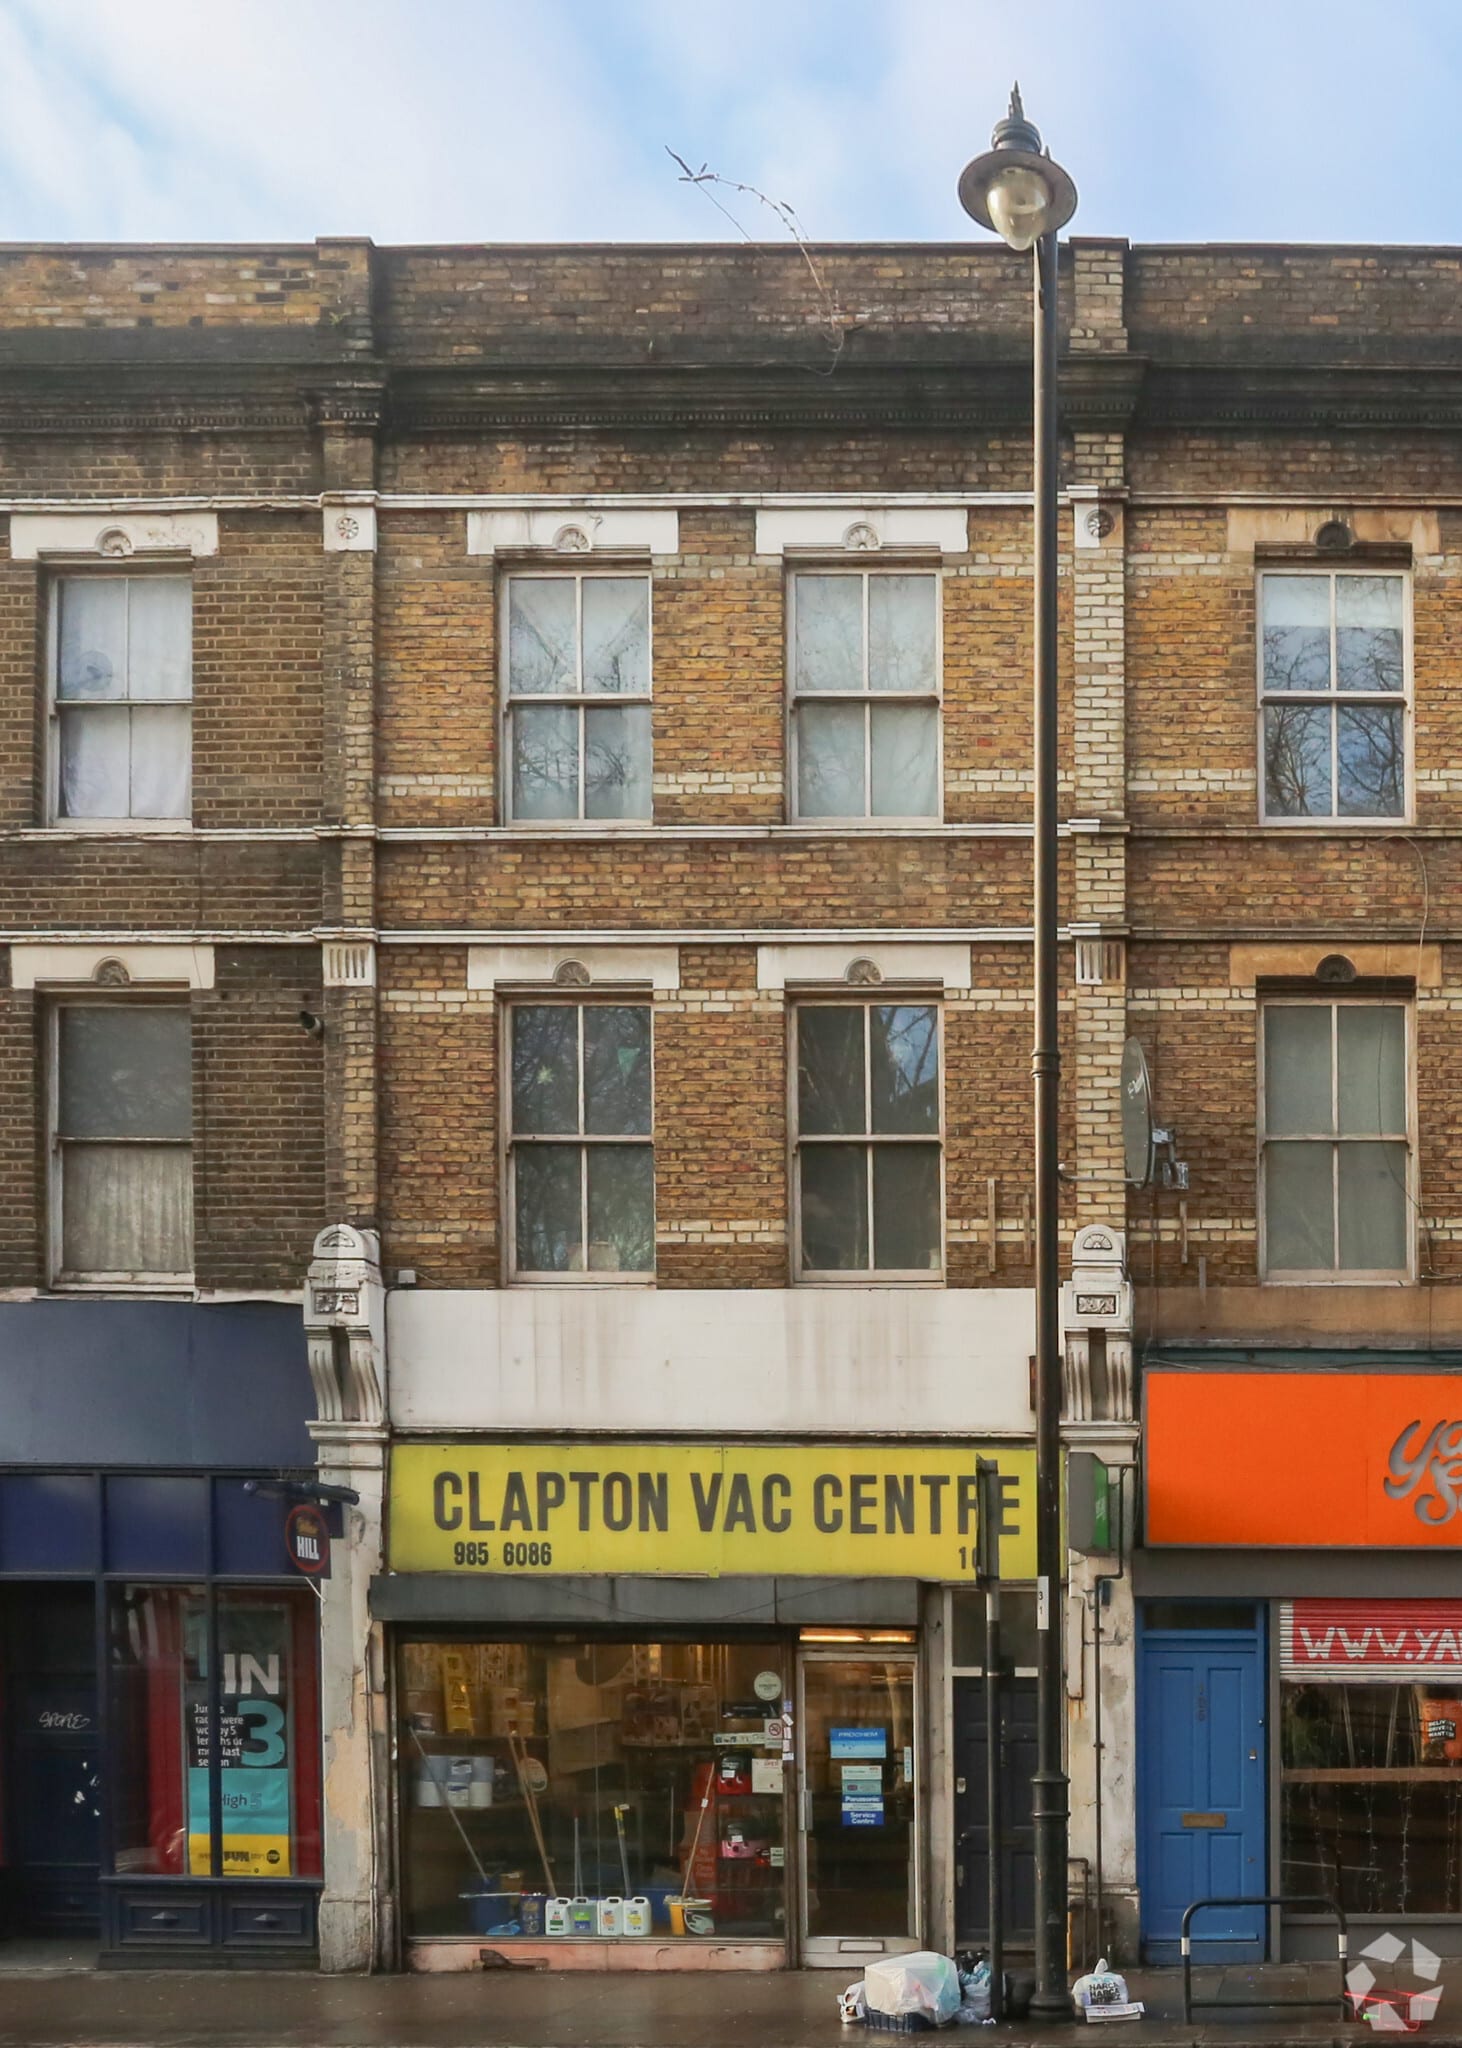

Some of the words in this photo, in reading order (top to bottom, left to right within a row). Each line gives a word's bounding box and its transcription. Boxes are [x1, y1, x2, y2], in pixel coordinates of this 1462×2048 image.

[433, 1471, 669, 1532] CLAPTON
[690, 1472, 792, 1533] VAC
[296, 1535, 320, 1560] HILL
[454, 1541, 489, 1566] 985
[503, 1541, 552, 1566] 6086
[223, 1653, 280, 1695] IN
[237, 1699, 286, 1767] 3
